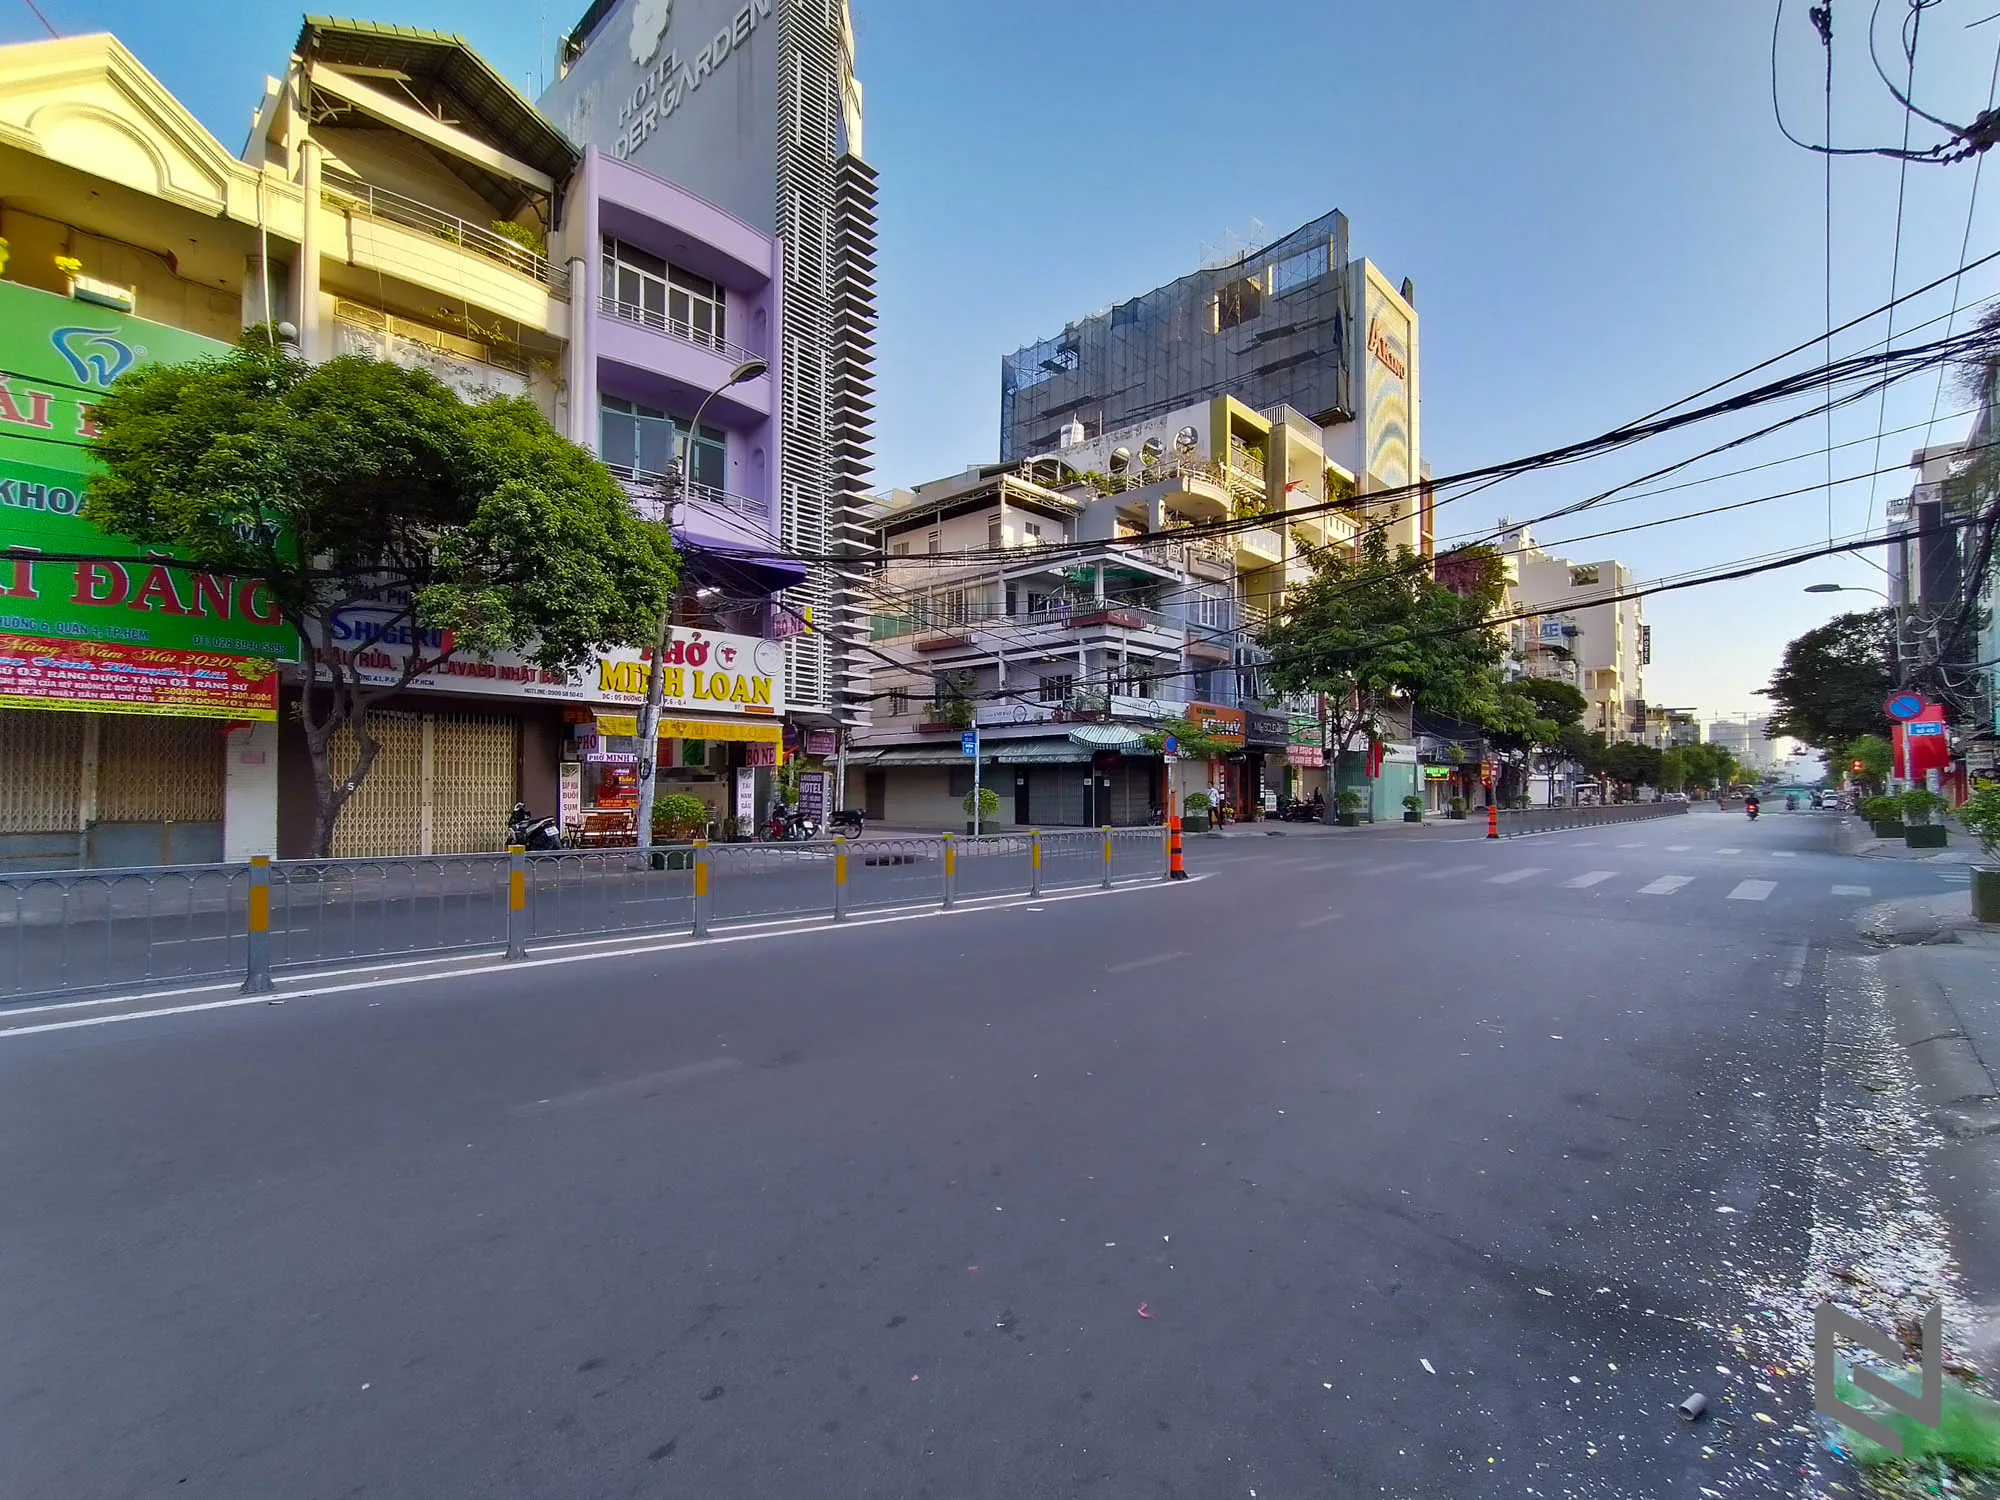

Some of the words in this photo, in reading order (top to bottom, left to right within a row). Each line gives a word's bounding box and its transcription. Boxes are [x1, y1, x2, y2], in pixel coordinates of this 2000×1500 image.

[618, 48, 684, 128] HOTEL
[0, 478, 86, 518] KHO
[70, 549, 285, 627] ĐĂNG
[180, 655, 233, 668] 2020
[17, 667, 42, 678] 03
[47, 670, 87, 681] RĂNG
[90, 673, 128, 684] ĐƯỢC
[131, 676, 167, 688] TẶNG
[169, 678, 191, 688] 01
[195, 680, 230, 691] RĂNG
[500, 664, 537, 686] NHẬT
[692, 670, 773, 705] LOAN
[606, 754, 630, 763] MINH
[801, 782, 822, 794] HOTEL
